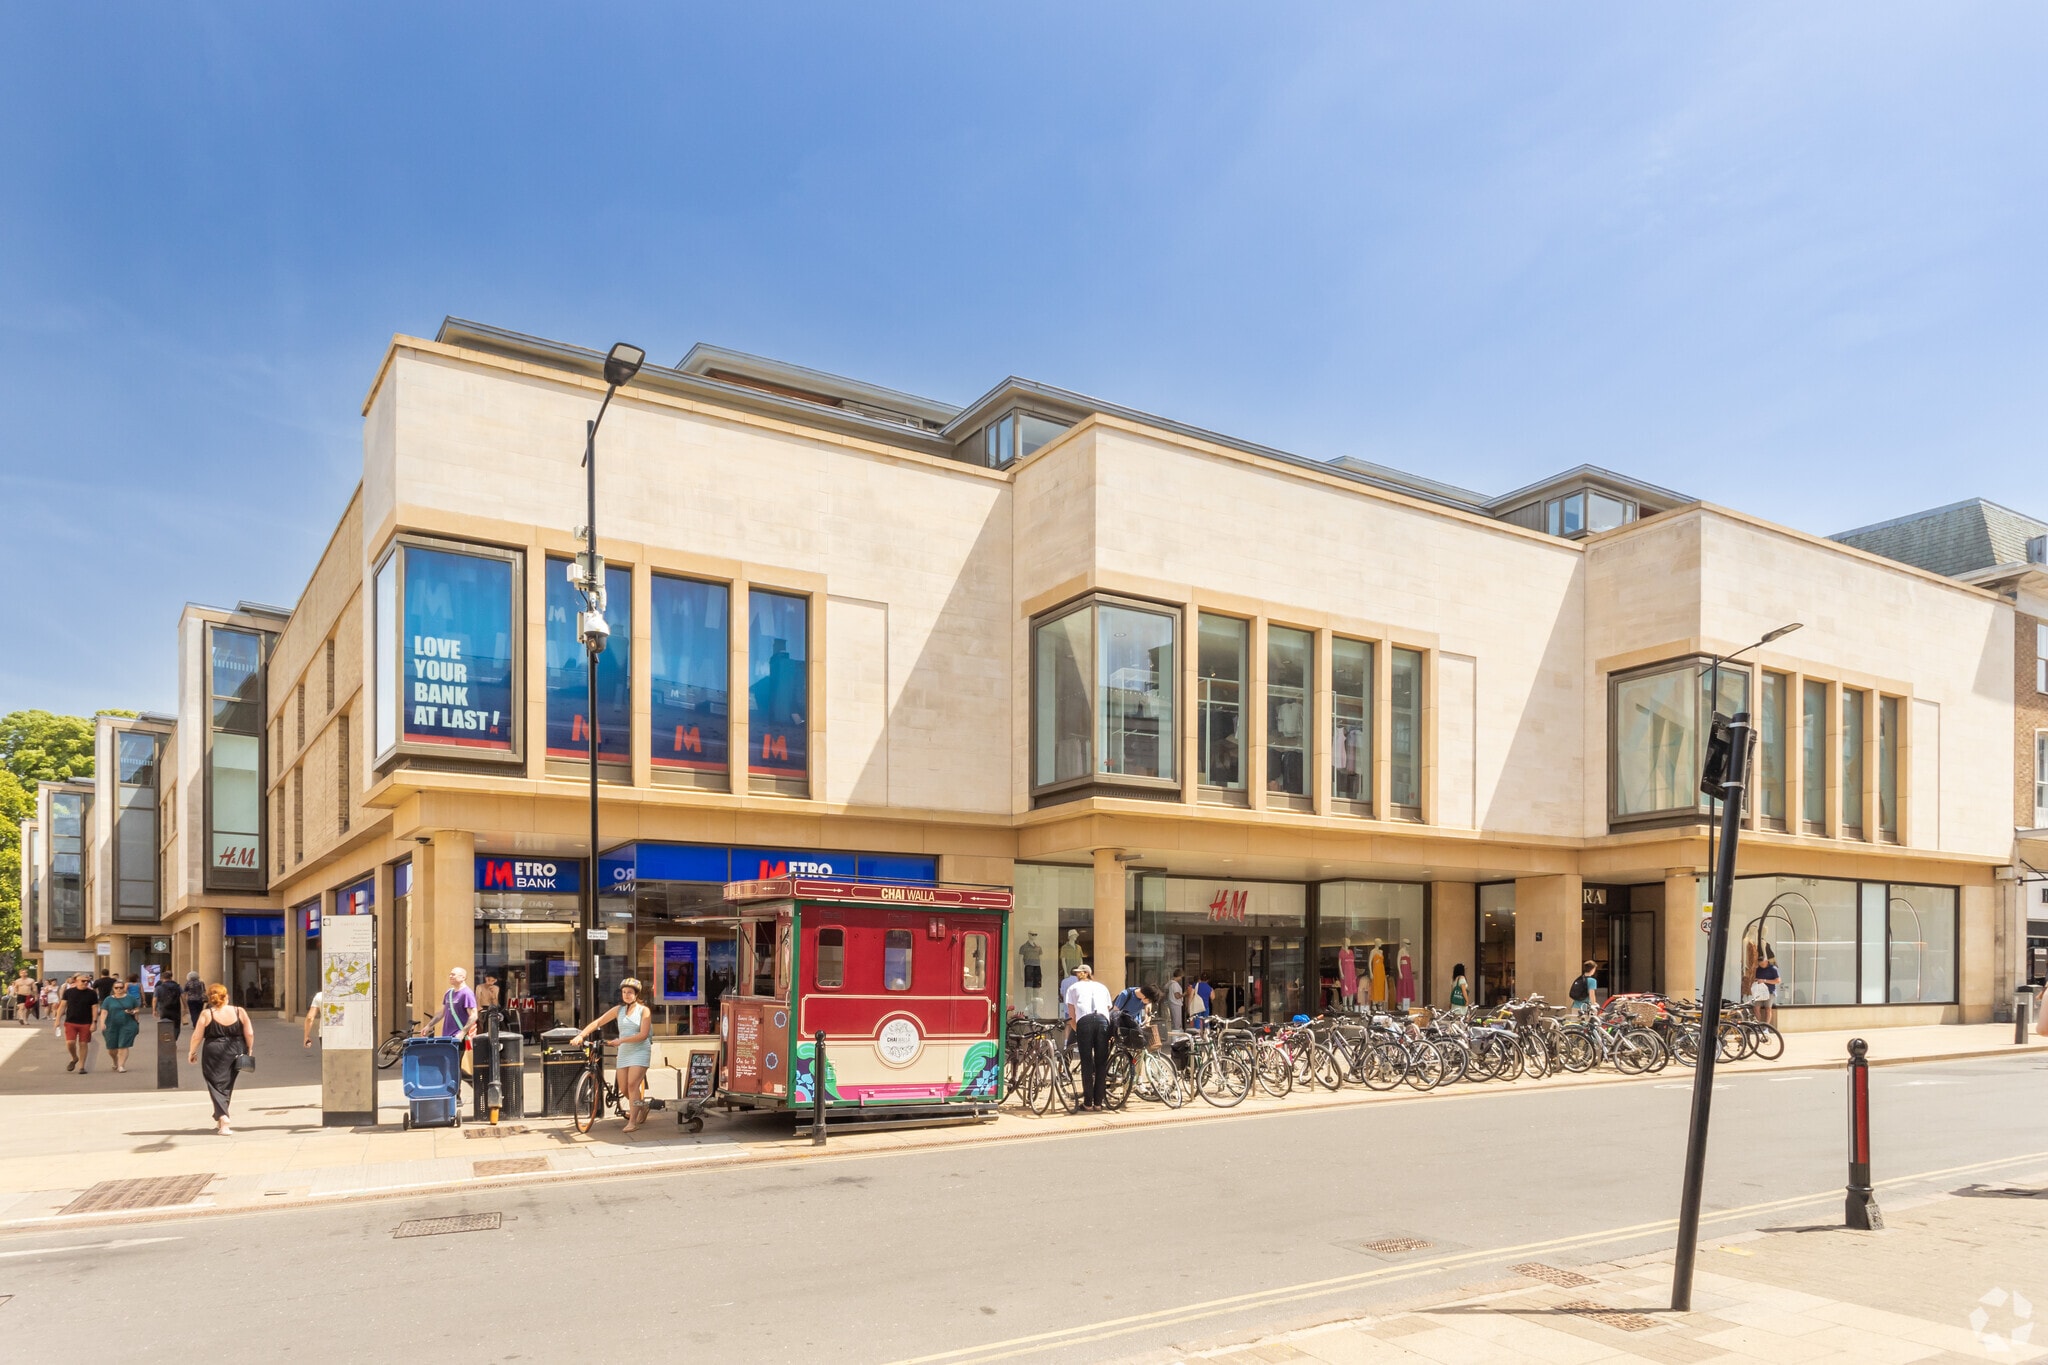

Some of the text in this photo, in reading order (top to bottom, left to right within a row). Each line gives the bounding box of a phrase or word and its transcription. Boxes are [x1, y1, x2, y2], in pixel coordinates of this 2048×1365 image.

[414, 635, 461, 660] LOVE
[414, 658, 467, 683] YOUR
[414, 682, 469, 707] BANK
[413, 705, 438, 727] AT
[673, 725, 702, 753] M
[762, 734, 788, 760] M
[219, 846, 256, 867] H&M
[484, 860, 558, 889] METRO
[758, 859, 834, 880] METRO
[516, 877, 557, 889] BANK
[881, 887, 935, 902] CHAI WALLA
[1207, 889, 1249, 923] H&M
